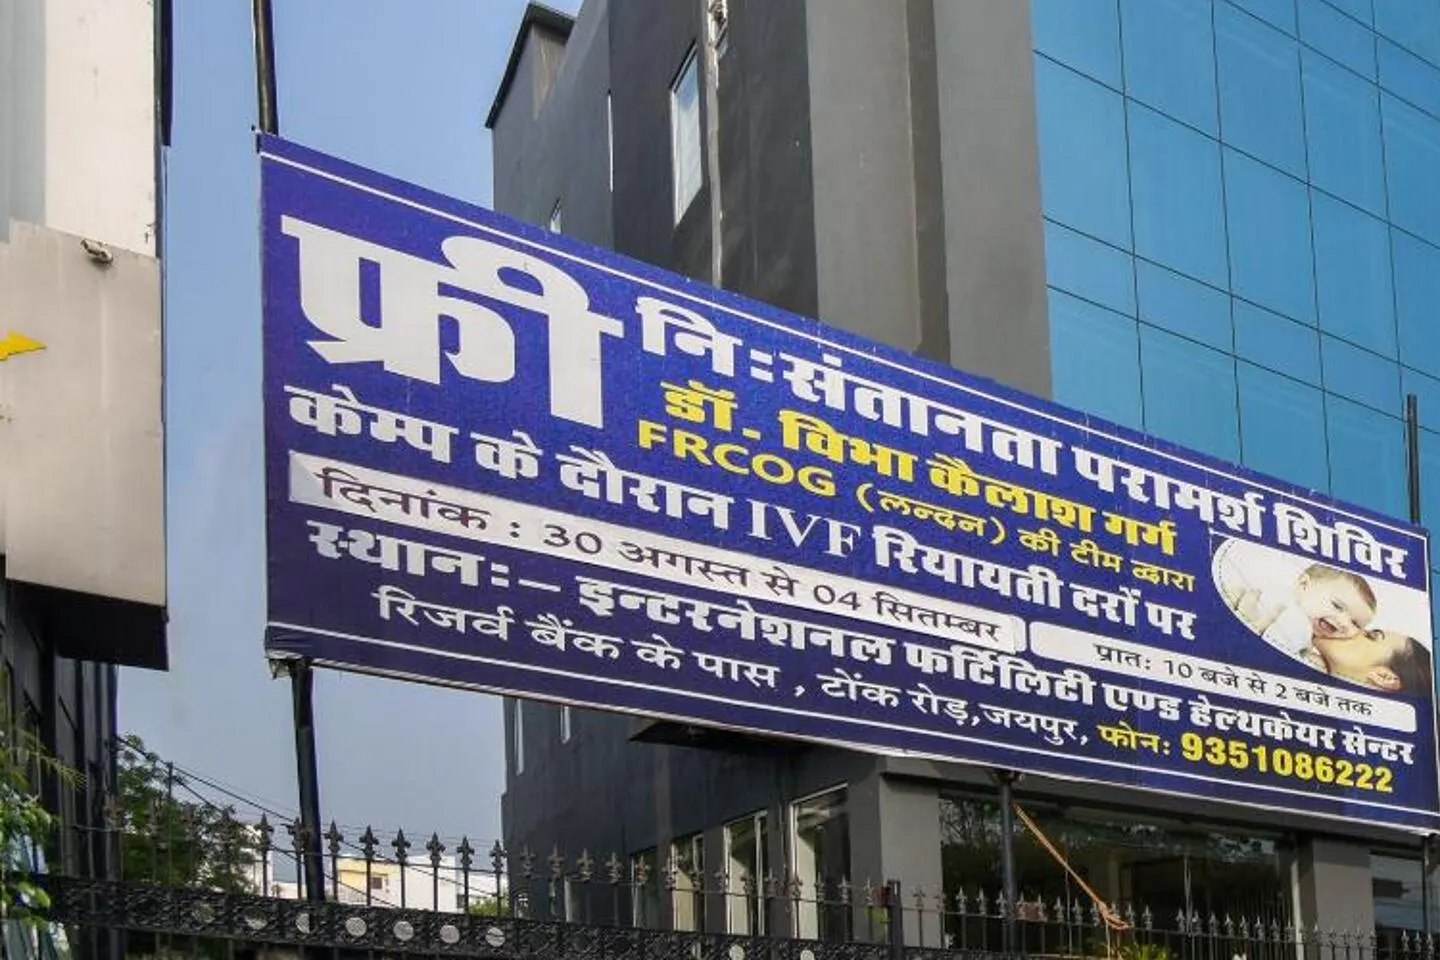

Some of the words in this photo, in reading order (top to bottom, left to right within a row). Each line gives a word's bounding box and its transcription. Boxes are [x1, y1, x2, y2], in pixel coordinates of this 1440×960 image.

[471, 430, 543, 479] के
[555, 445, 735, 530] दौरान
[746, 499, 861, 557] IVF
[872, 526, 1063, 608] रियायती
[1069, 586, 1142, 626] दरों
[1144, 601, 1196, 640] पर
[638, 420, 836, 496] FRCOG
[1017, 527, 1060, 557] की
[1070, 541, 1121, 573] टीम
[778, 409, 918, 482] विभा
[927, 453, 1097, 532] कैलाश
[1103, 510, 1177, 556] गर्ग
[1072, 446, 1265, 537] परामर्श
[1273, 502, 1408, 579] शिविर
[543, 524, 602, 554] 30
[616, 540, 748, 588] अगस्त
[761, 566, 799, 597] से
[813, 585, 861, 611] 04
[872, 591, 1000, 642] सितम्बर
[371, 585, 515, 641] रिजर्व
[525, 612, 624, 660] बैंक
[631, 633, 685, 670] के
[816, 668, 901, 708] टोंक
[1181, 732, 1393, 792] 9351086222
[576, 576, 897, 665] इन्टरनेशनल
[1102, 683, 1181, 720] एण्ड
[1342, 726, 1415, 765] सेन्टर
[1164, 660, 1193, 678] 10
[1199, 665, 1239, 689] बजे
[1245, 676, 1266, 694] से
[1276, 683, 1287, 699] 2
[1293, 686, 1332, 709] बजे
[1335, 697, 1374, 716] तक
